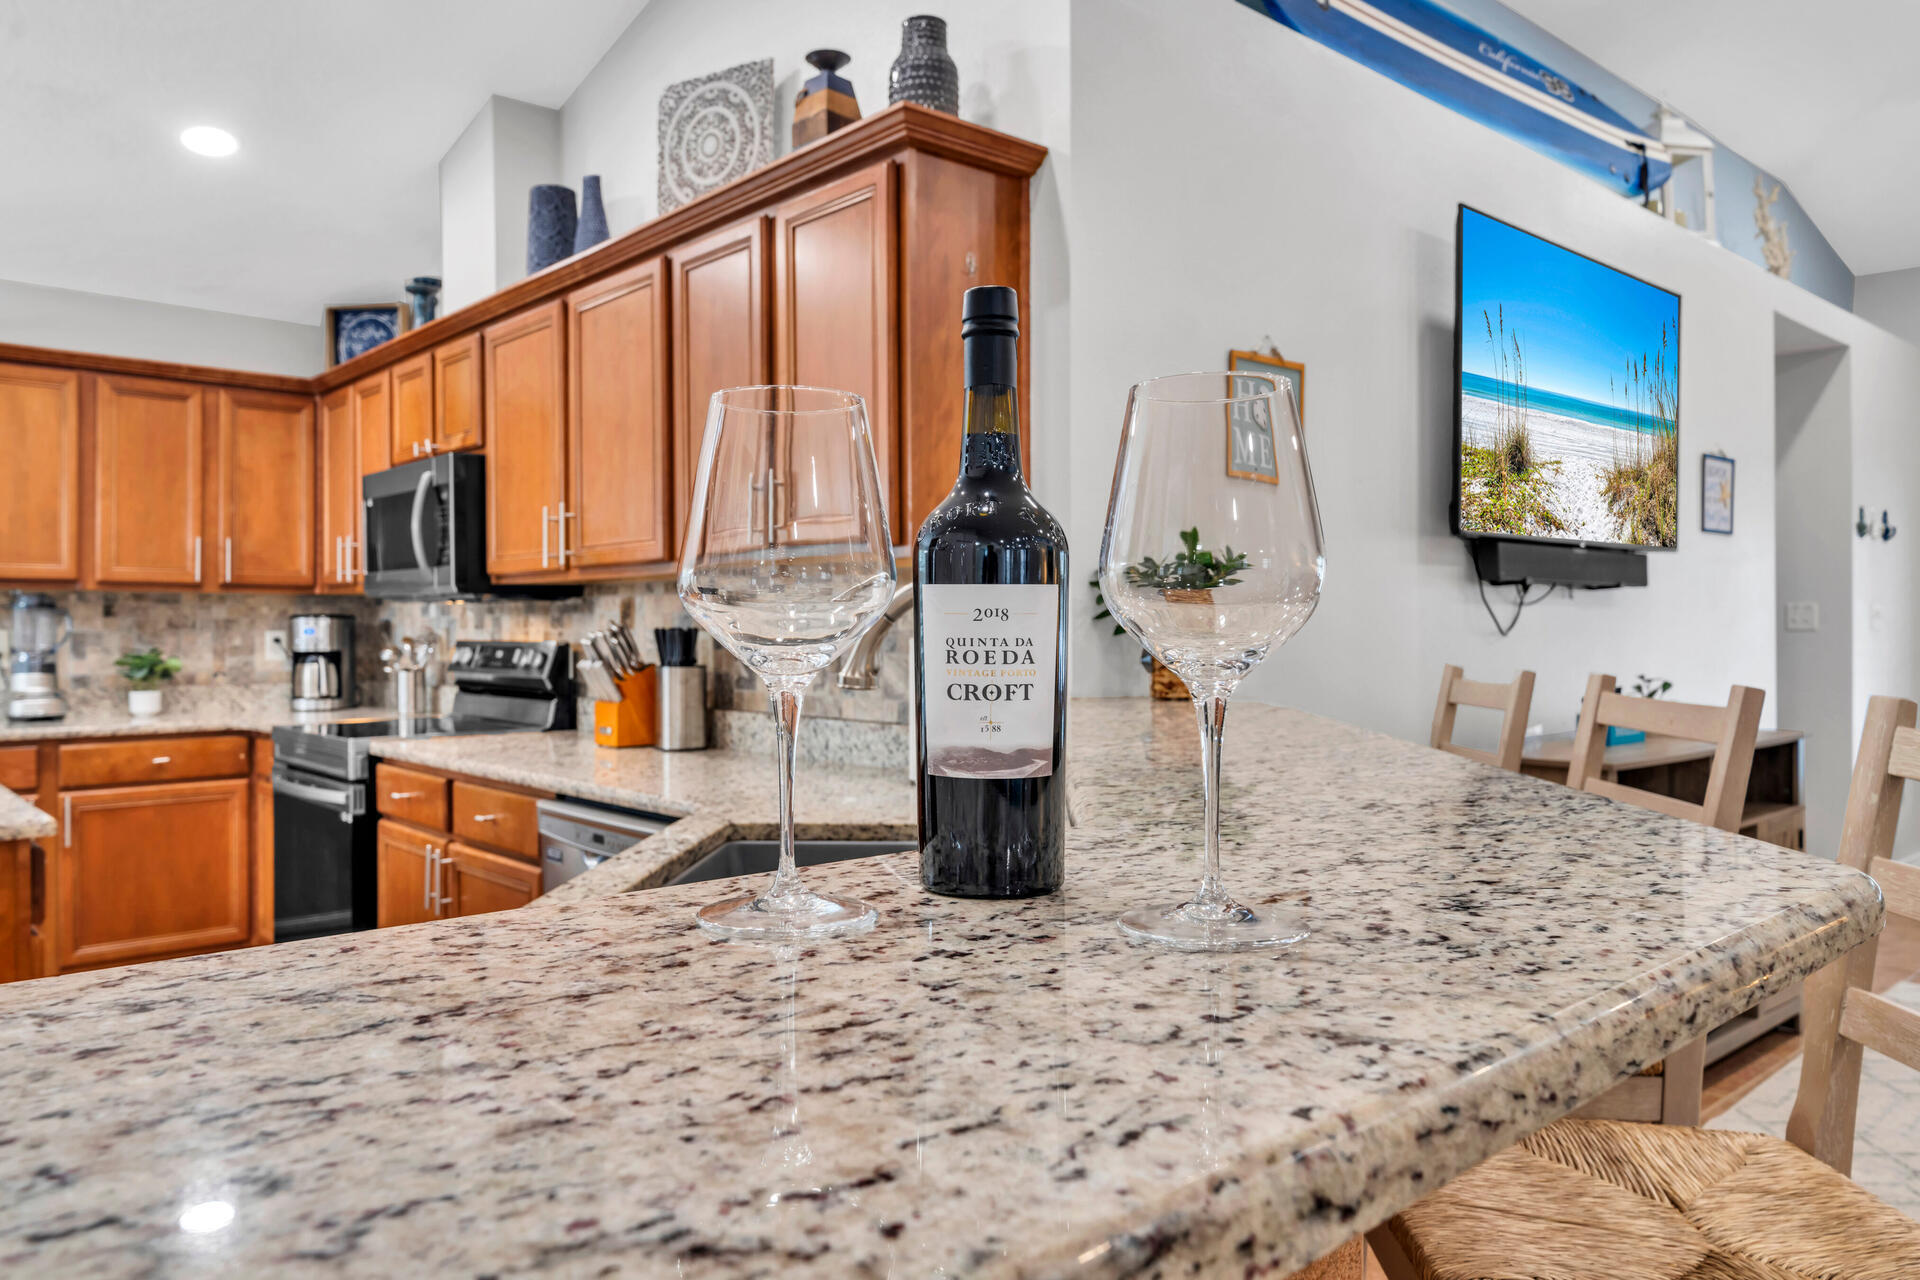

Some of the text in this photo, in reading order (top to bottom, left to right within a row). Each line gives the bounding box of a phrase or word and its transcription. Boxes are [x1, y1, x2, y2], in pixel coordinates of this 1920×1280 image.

[973, 608, 1009, 622] 2018
[945, 637, 1034, 649] QUINTA DA
[945, 649, 1035, 665] ROEDA
[946, 669, 1037, 677] VINTAGE PORTO
[946, 683, 1035, 701] CROFT
